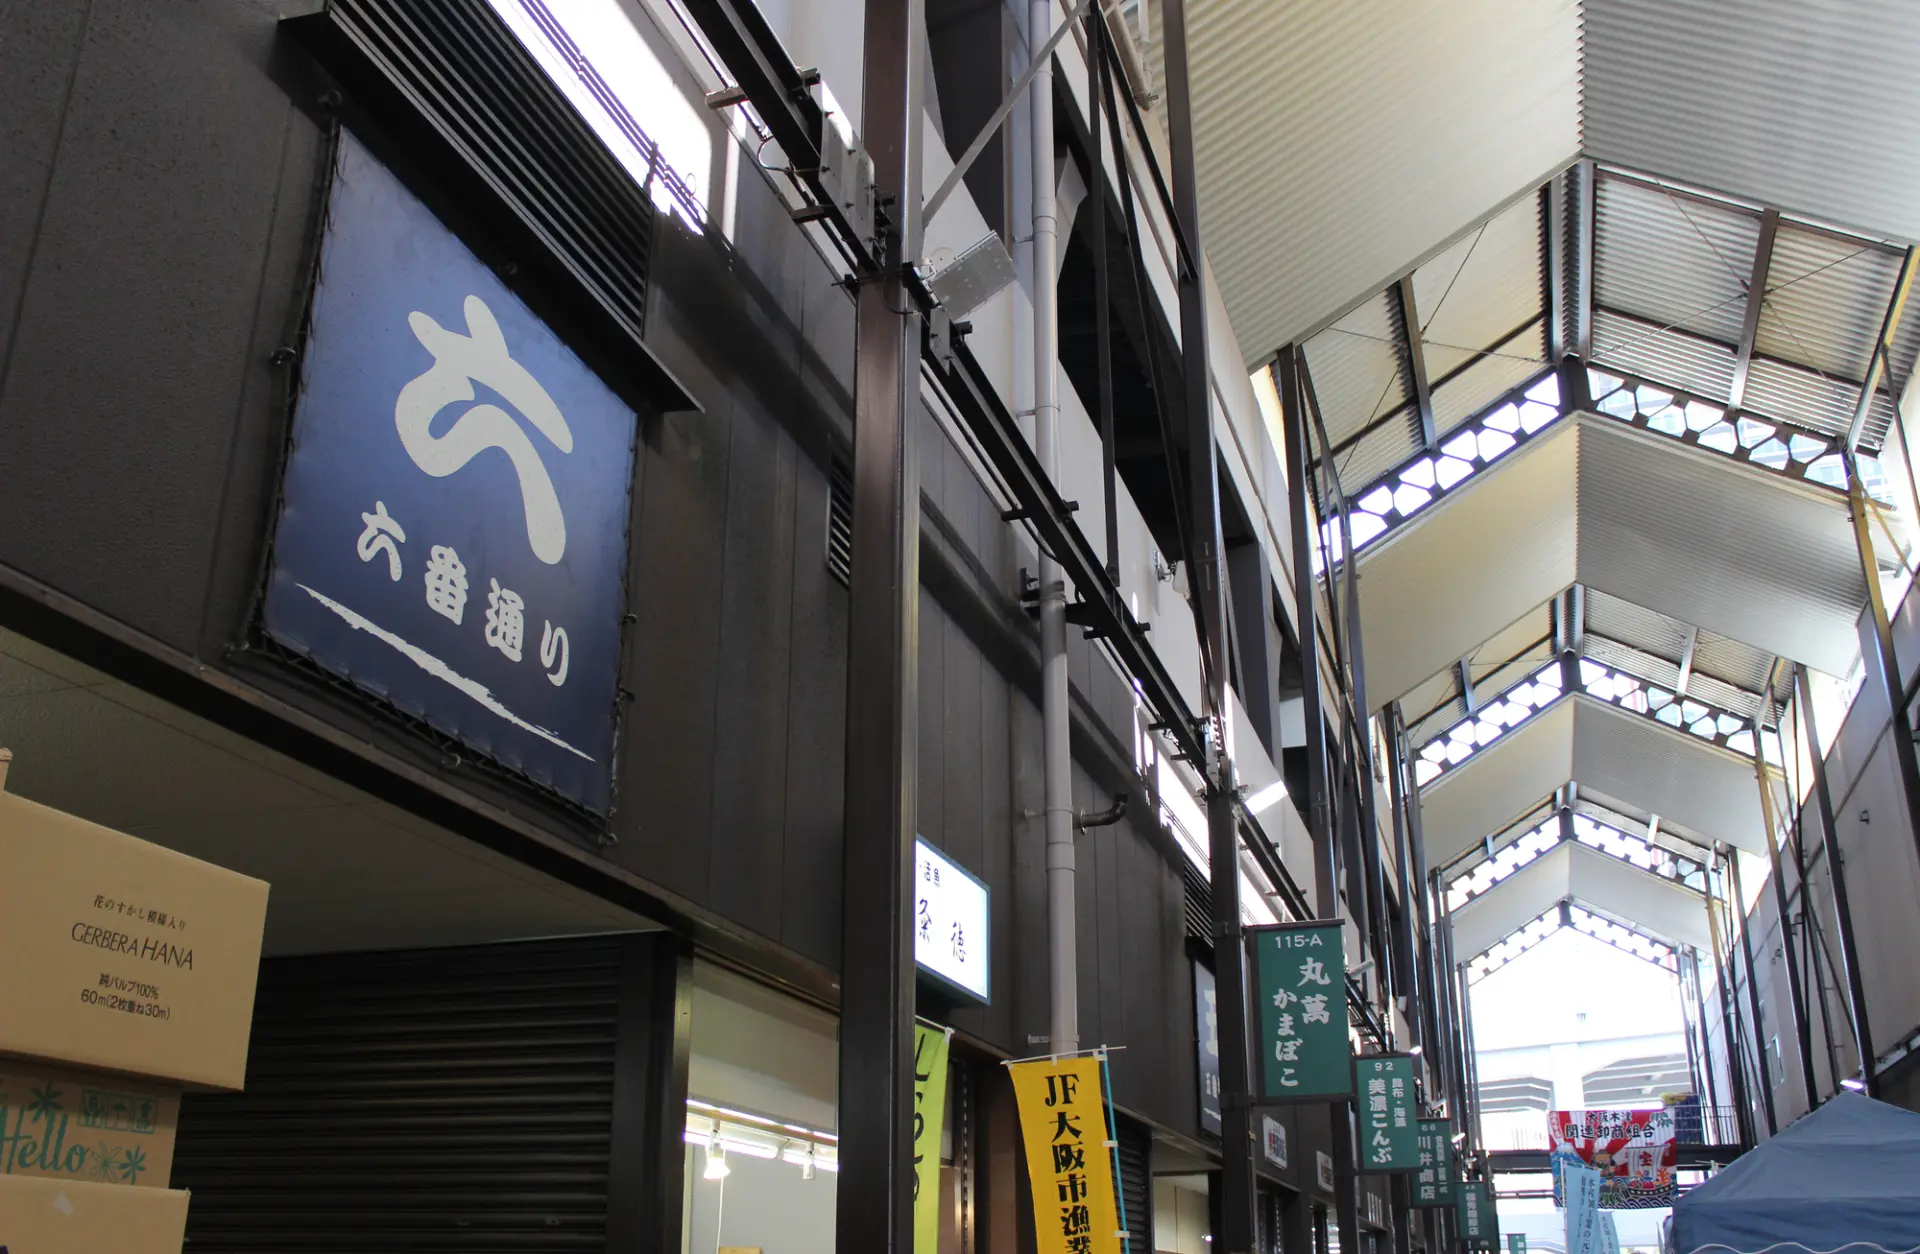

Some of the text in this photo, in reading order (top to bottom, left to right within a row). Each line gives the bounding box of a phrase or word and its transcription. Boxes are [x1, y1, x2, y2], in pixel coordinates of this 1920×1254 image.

[357, 501, 570, 686] 六番通り
[94, 894, 187, 932] 花のすかし模様入り
[1275, 933, 1323, 949] 115-A
[71, 922, 193, 971] GERBERA HANA
[1297, 956, 1331, 1025] 丸萬
[1272, 988, 1304, 1087] かまぼこ
[1374, 1061, 1394, 1072] 92
[0, 1104, 89, 1175] Hello
[1368, 1078, 1393, 1163] 美濃こんぶ
[1565, 1123, 1656, 1139] 関連卸商組合
